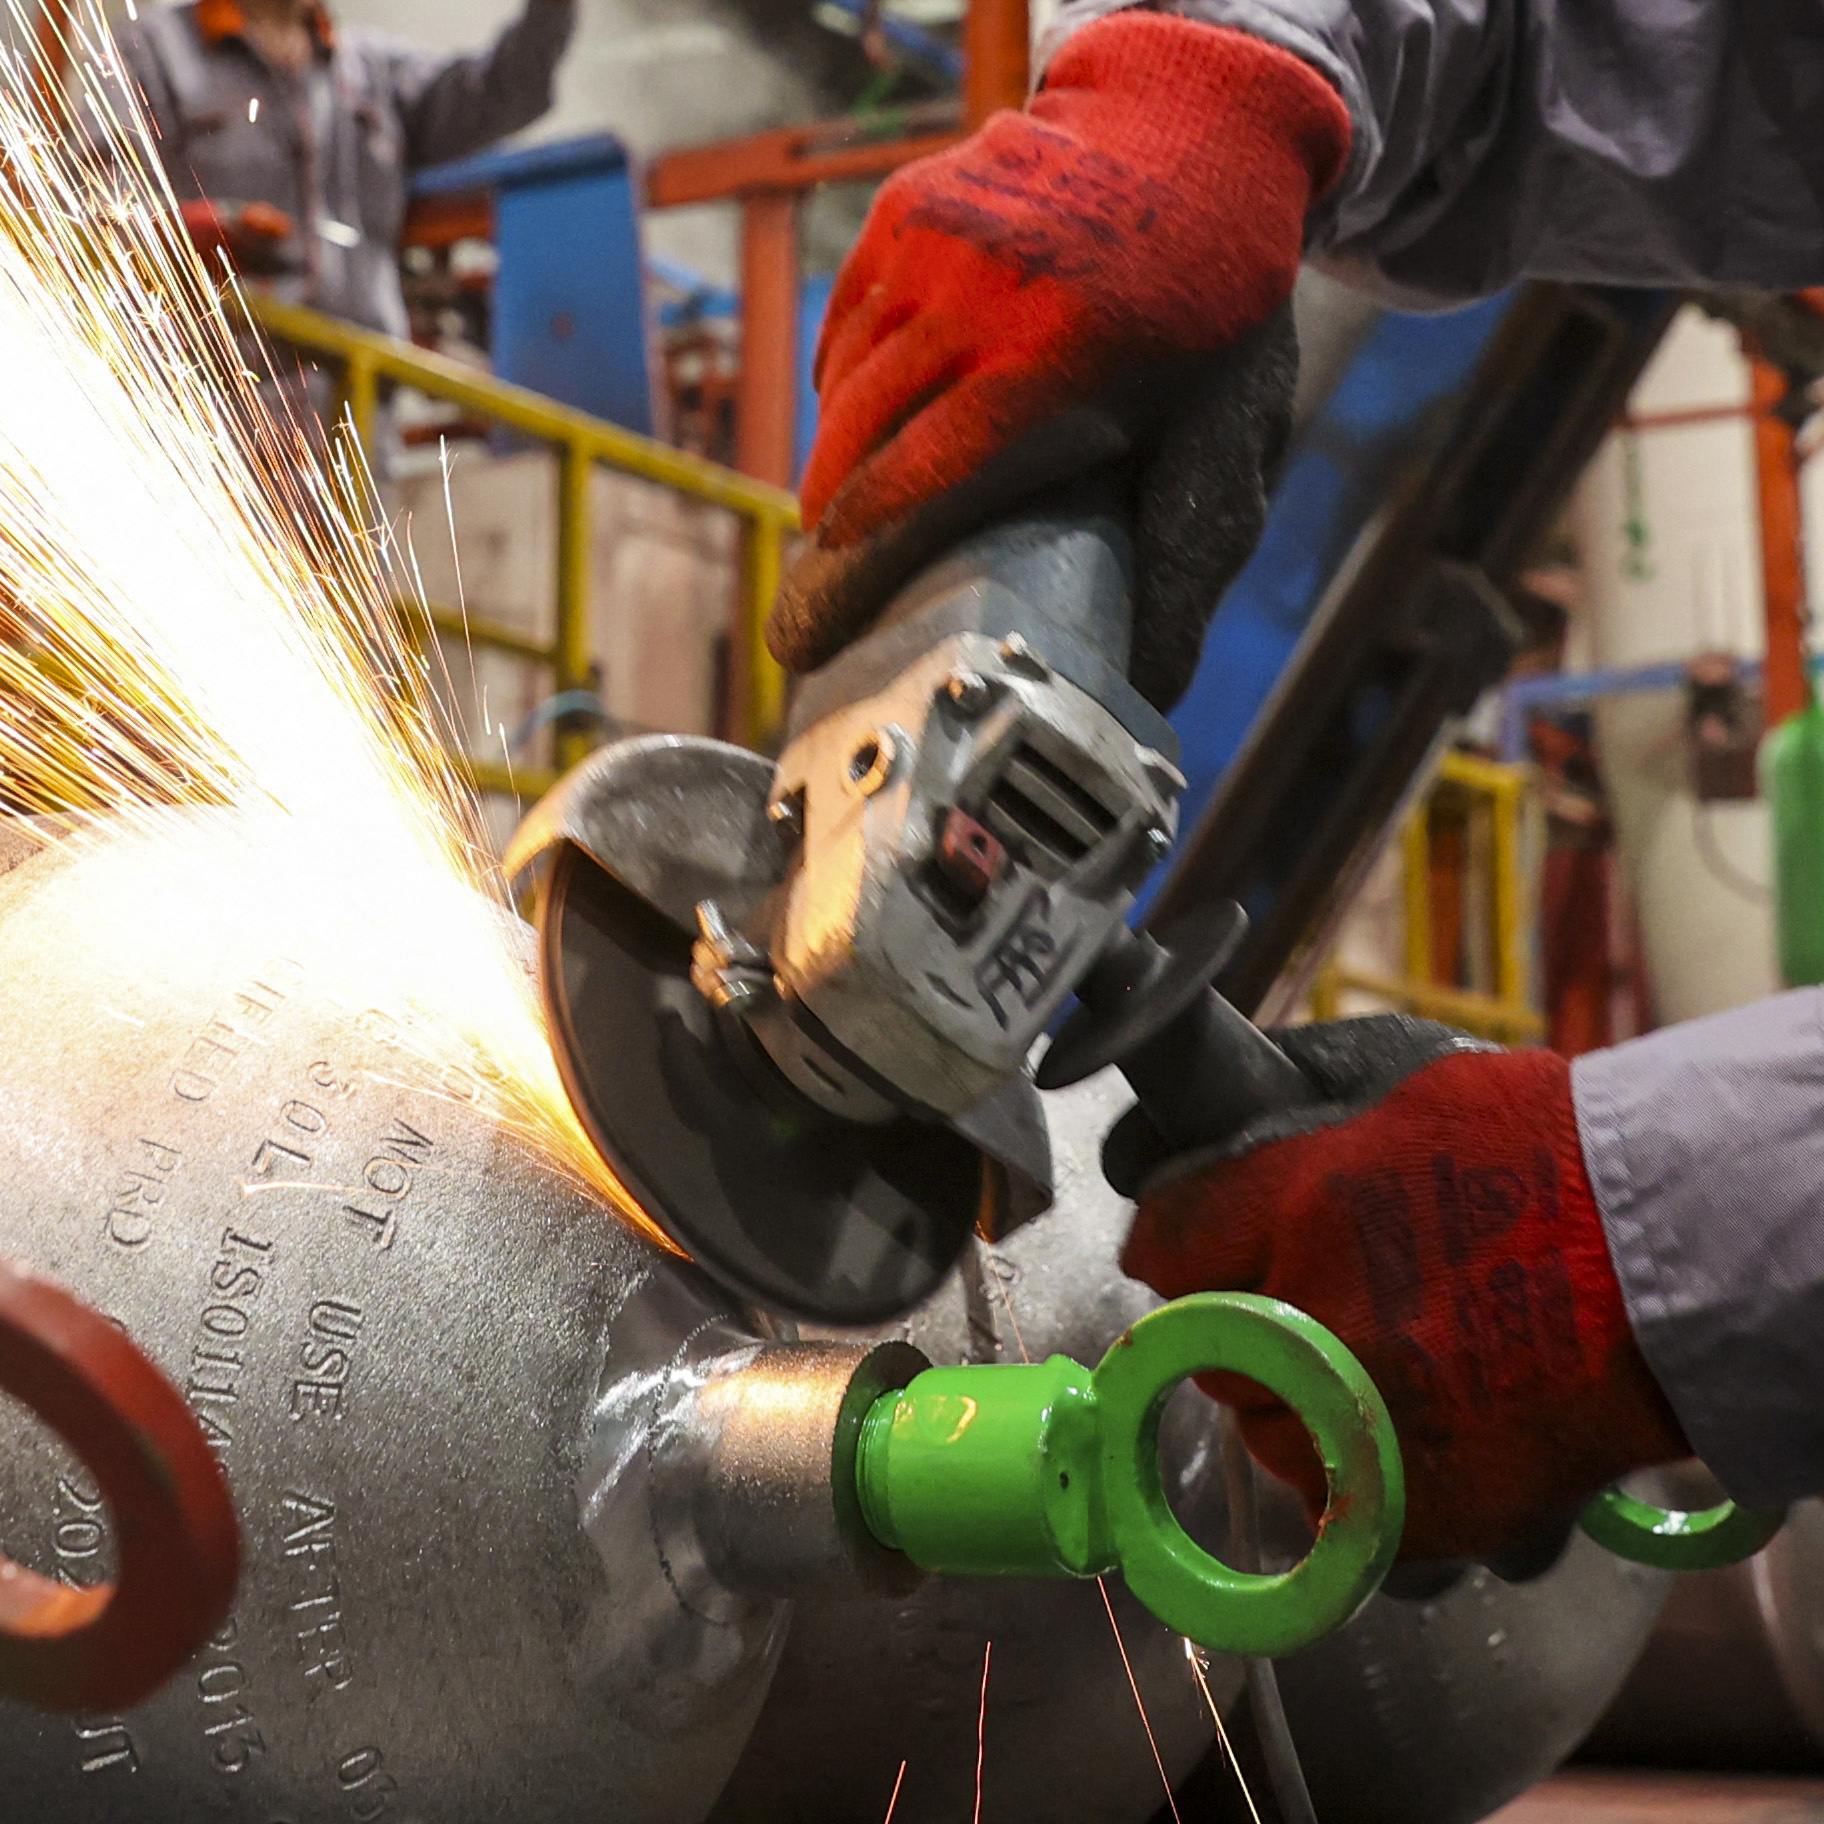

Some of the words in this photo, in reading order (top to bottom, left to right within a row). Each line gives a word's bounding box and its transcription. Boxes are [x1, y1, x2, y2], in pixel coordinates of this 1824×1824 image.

[103, 1137, 183, 1255] PRD
[342, 1116, 435, 1251] NOT
[288, 1297, 366, 1423] USE
[280, 1488, 355, 1692] AFTER
